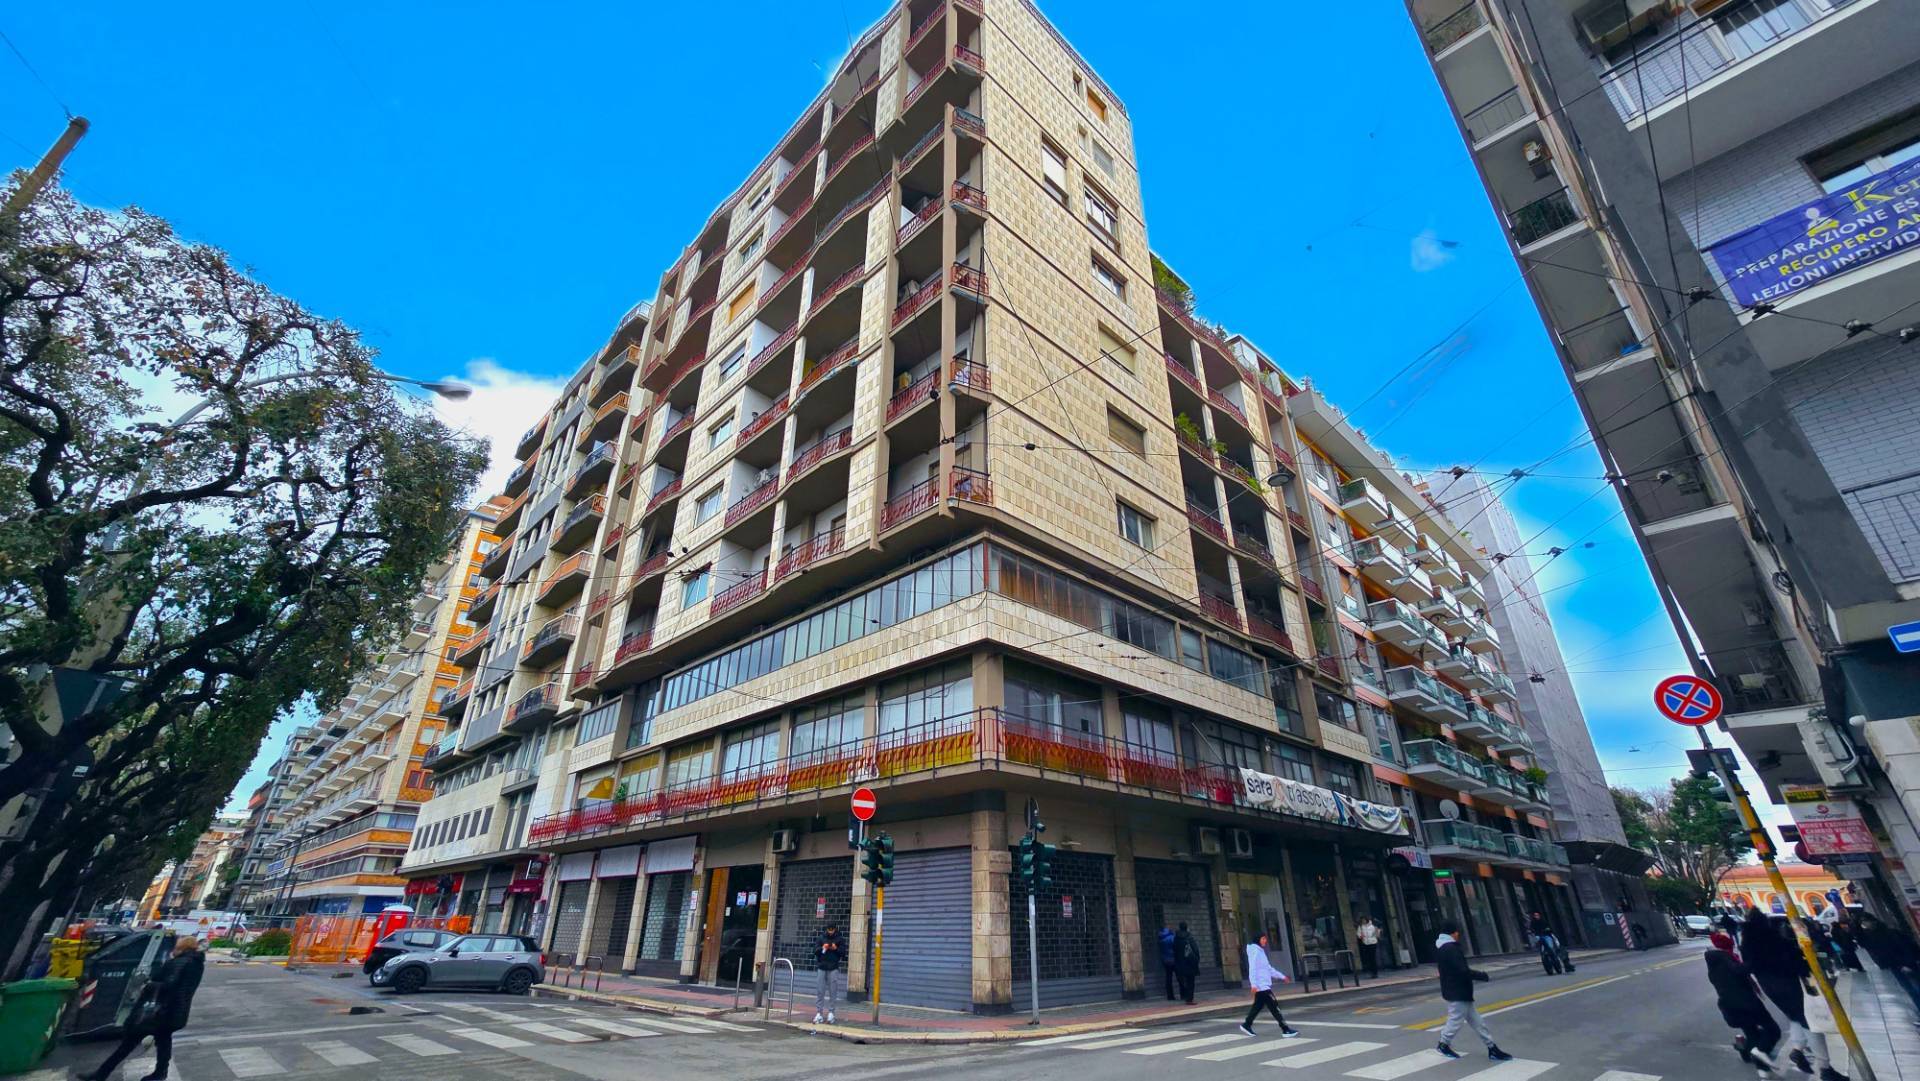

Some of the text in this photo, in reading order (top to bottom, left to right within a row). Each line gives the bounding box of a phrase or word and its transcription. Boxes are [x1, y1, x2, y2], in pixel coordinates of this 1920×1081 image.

[1735, 209, 1888, 277] PREPARAZIONE
[1752, 227, 1920, 301] LEZIONI INDIVID
[1779, 227, 1888, 276] RECUPERO
[1246, 777, 1273, 797] sara
